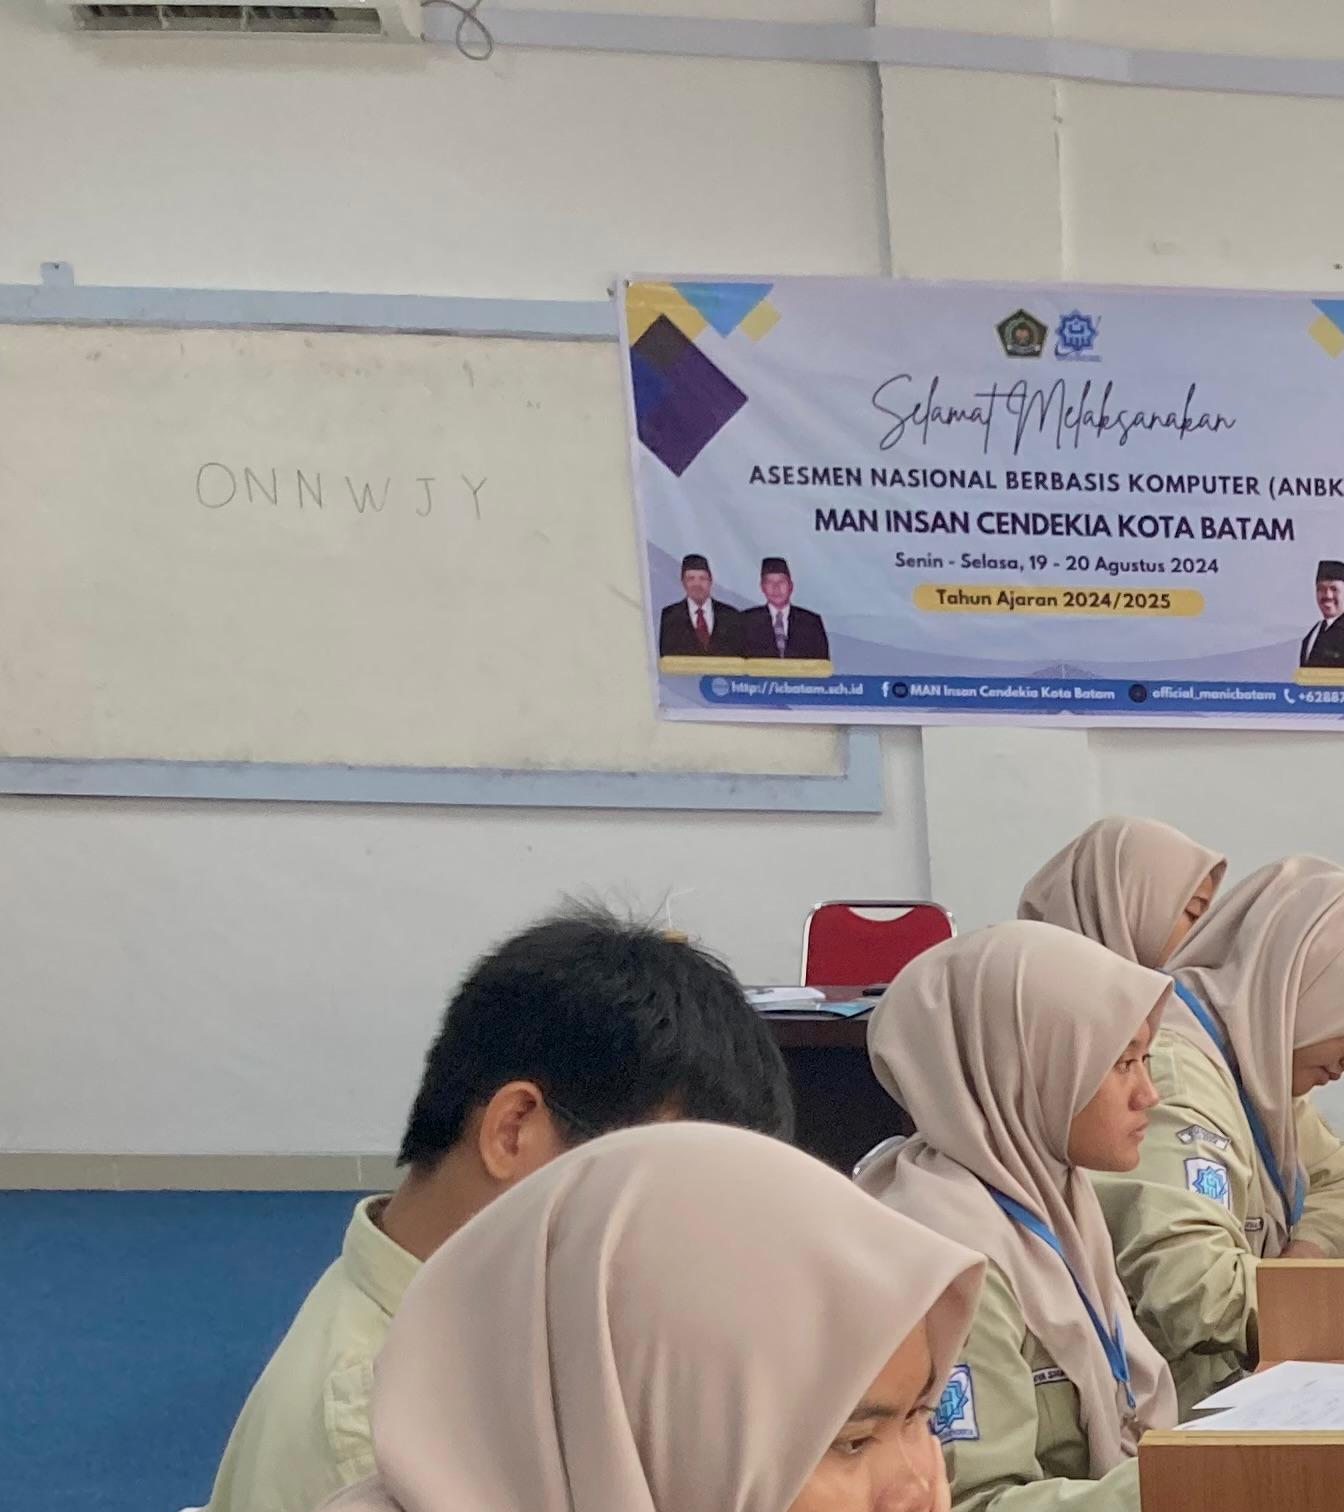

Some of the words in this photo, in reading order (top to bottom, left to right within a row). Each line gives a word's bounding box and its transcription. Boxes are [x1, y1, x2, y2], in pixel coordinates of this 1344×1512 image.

[872, 374, 1000, 454] Selamat
[1007, 378, 1236, 455] Melaksanakan
[749, 465, 862, 487] ASESMEN
[871, 468, 997, 490] NASIONAL
[1005, 471, 1120, 492] BERBASIS
[1129, 473, 1261, 496] KOMPUTER
[815, 508, 879, 533] MAN
[886, 510, 970, 534] INSAN
[976, 511, 1113, 537] CENDEKIA
[1118, 514, 1195, 540] KOTA
[1201, 517, 1295, 541] BATAM
[895, 552, 943, 569] Senin
[961, 553, 1024, 572] Selasa,
[1030, 555, 1048, 570] 19
[1066, 555, 1090, 571] 20
[1095, 556, 1165, 576] Agustus
[1171, 558, 1219, 573] 2024
[936, 589, 992, 606] Tahun
[996, 590, 1058, 610] Ajaran
[1063, 591, 1171, 610] 2024/2025
[910, 683, 941, 698] MAN
[944, 684, 977, 698] Insan
[979, 684, 1039, 699] Cendekia
[1041, 685, 1072, 699] Kota
[1075, 687, 1116, 700] Batam
[1152, 685, 1277, 701] official_manicbatam
